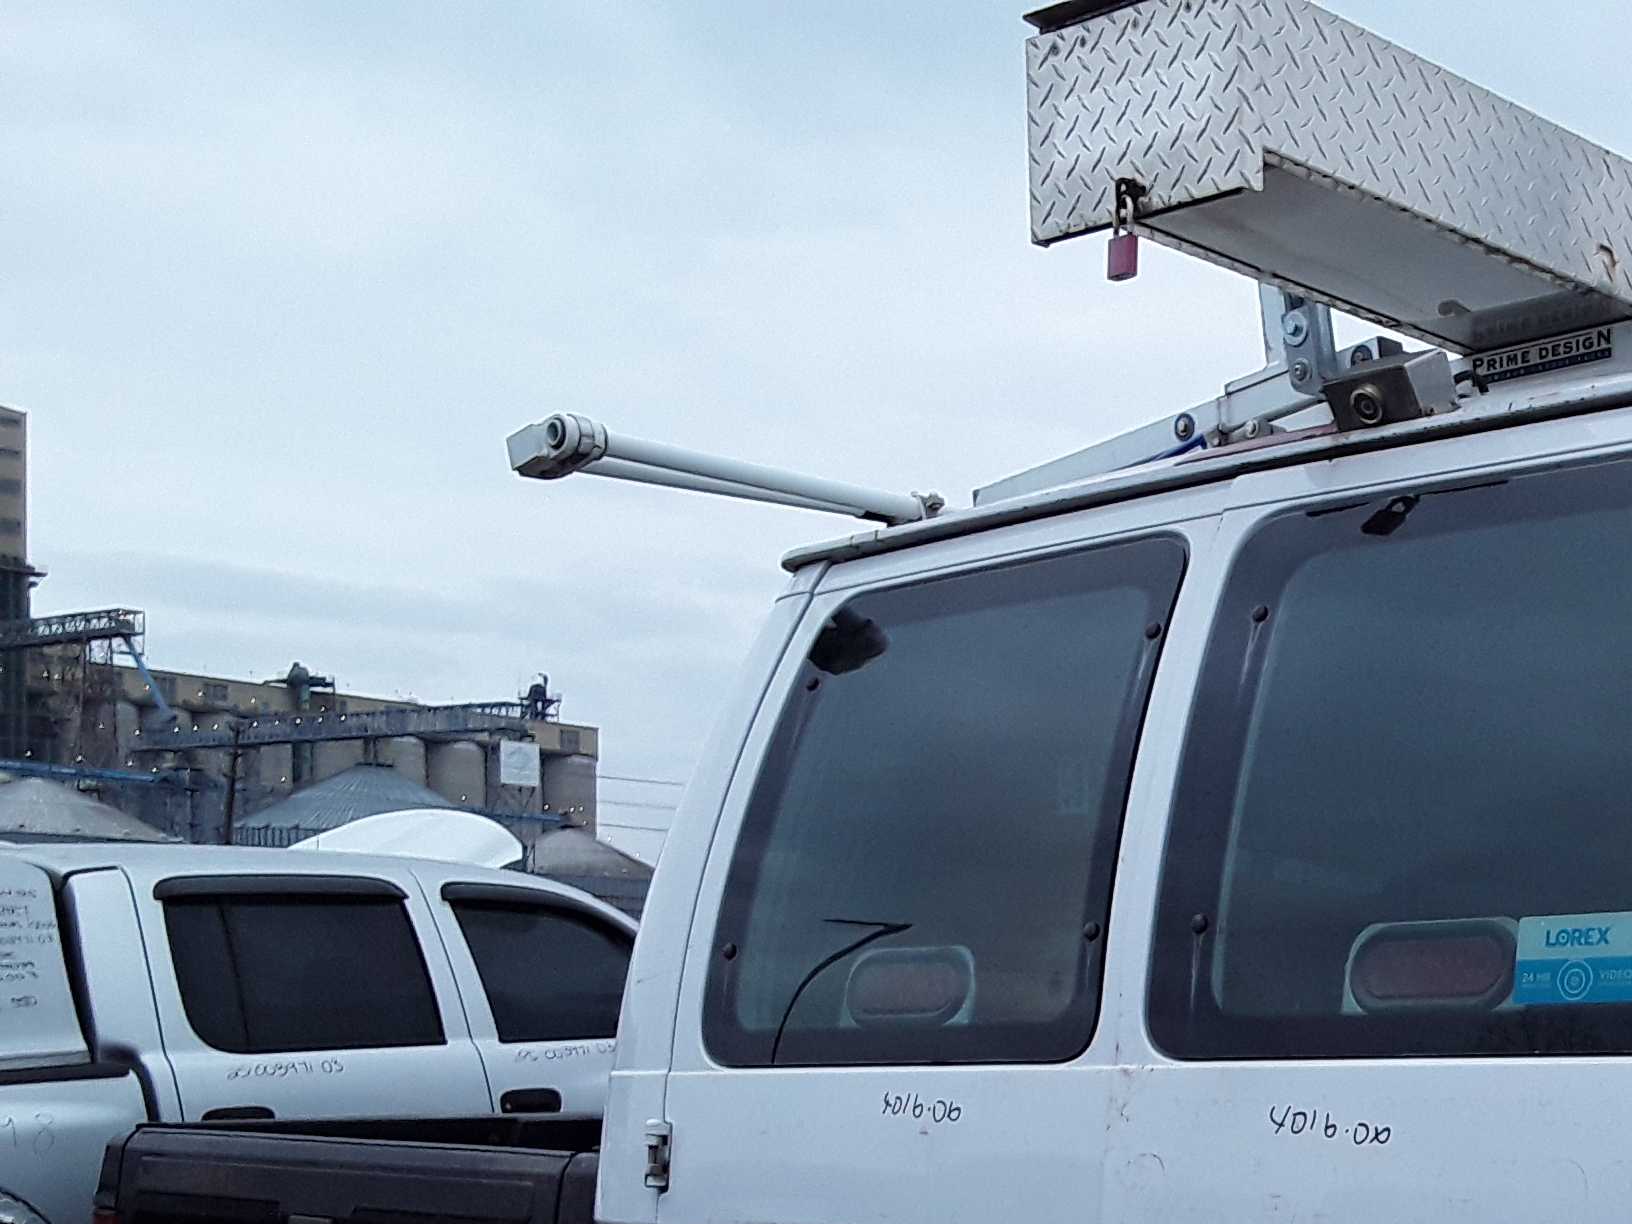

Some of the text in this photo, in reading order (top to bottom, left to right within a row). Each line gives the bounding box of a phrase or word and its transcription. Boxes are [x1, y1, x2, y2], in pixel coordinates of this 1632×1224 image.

[1472, 350, 1531, 373] PRIME
[1538, 328, 1611, 359] DESIGN
[1545, 926, 1611, 948] LOREX
